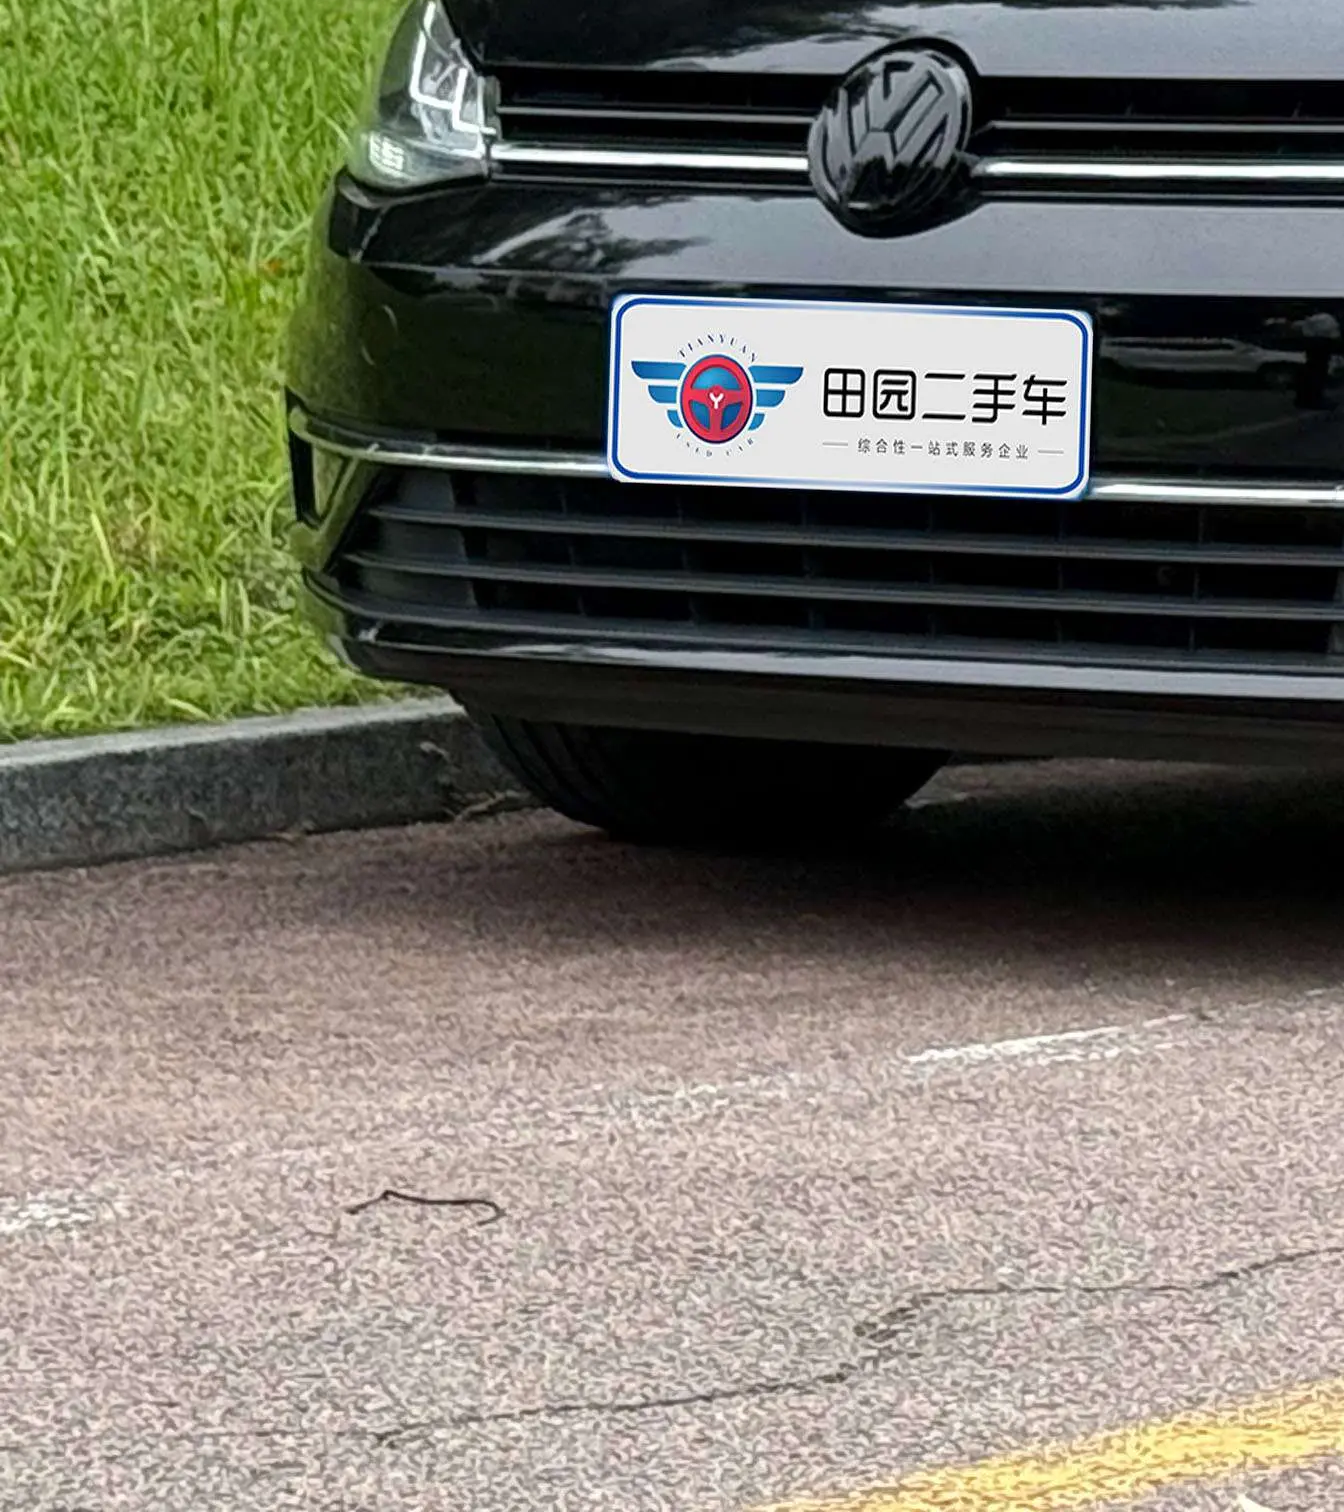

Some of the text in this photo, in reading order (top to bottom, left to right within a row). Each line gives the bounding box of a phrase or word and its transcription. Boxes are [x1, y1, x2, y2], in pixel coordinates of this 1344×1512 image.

[823, 367, 1068, 426] 田园二手车
[857, 438, 1029, 460] 综合性一站式服务企业
